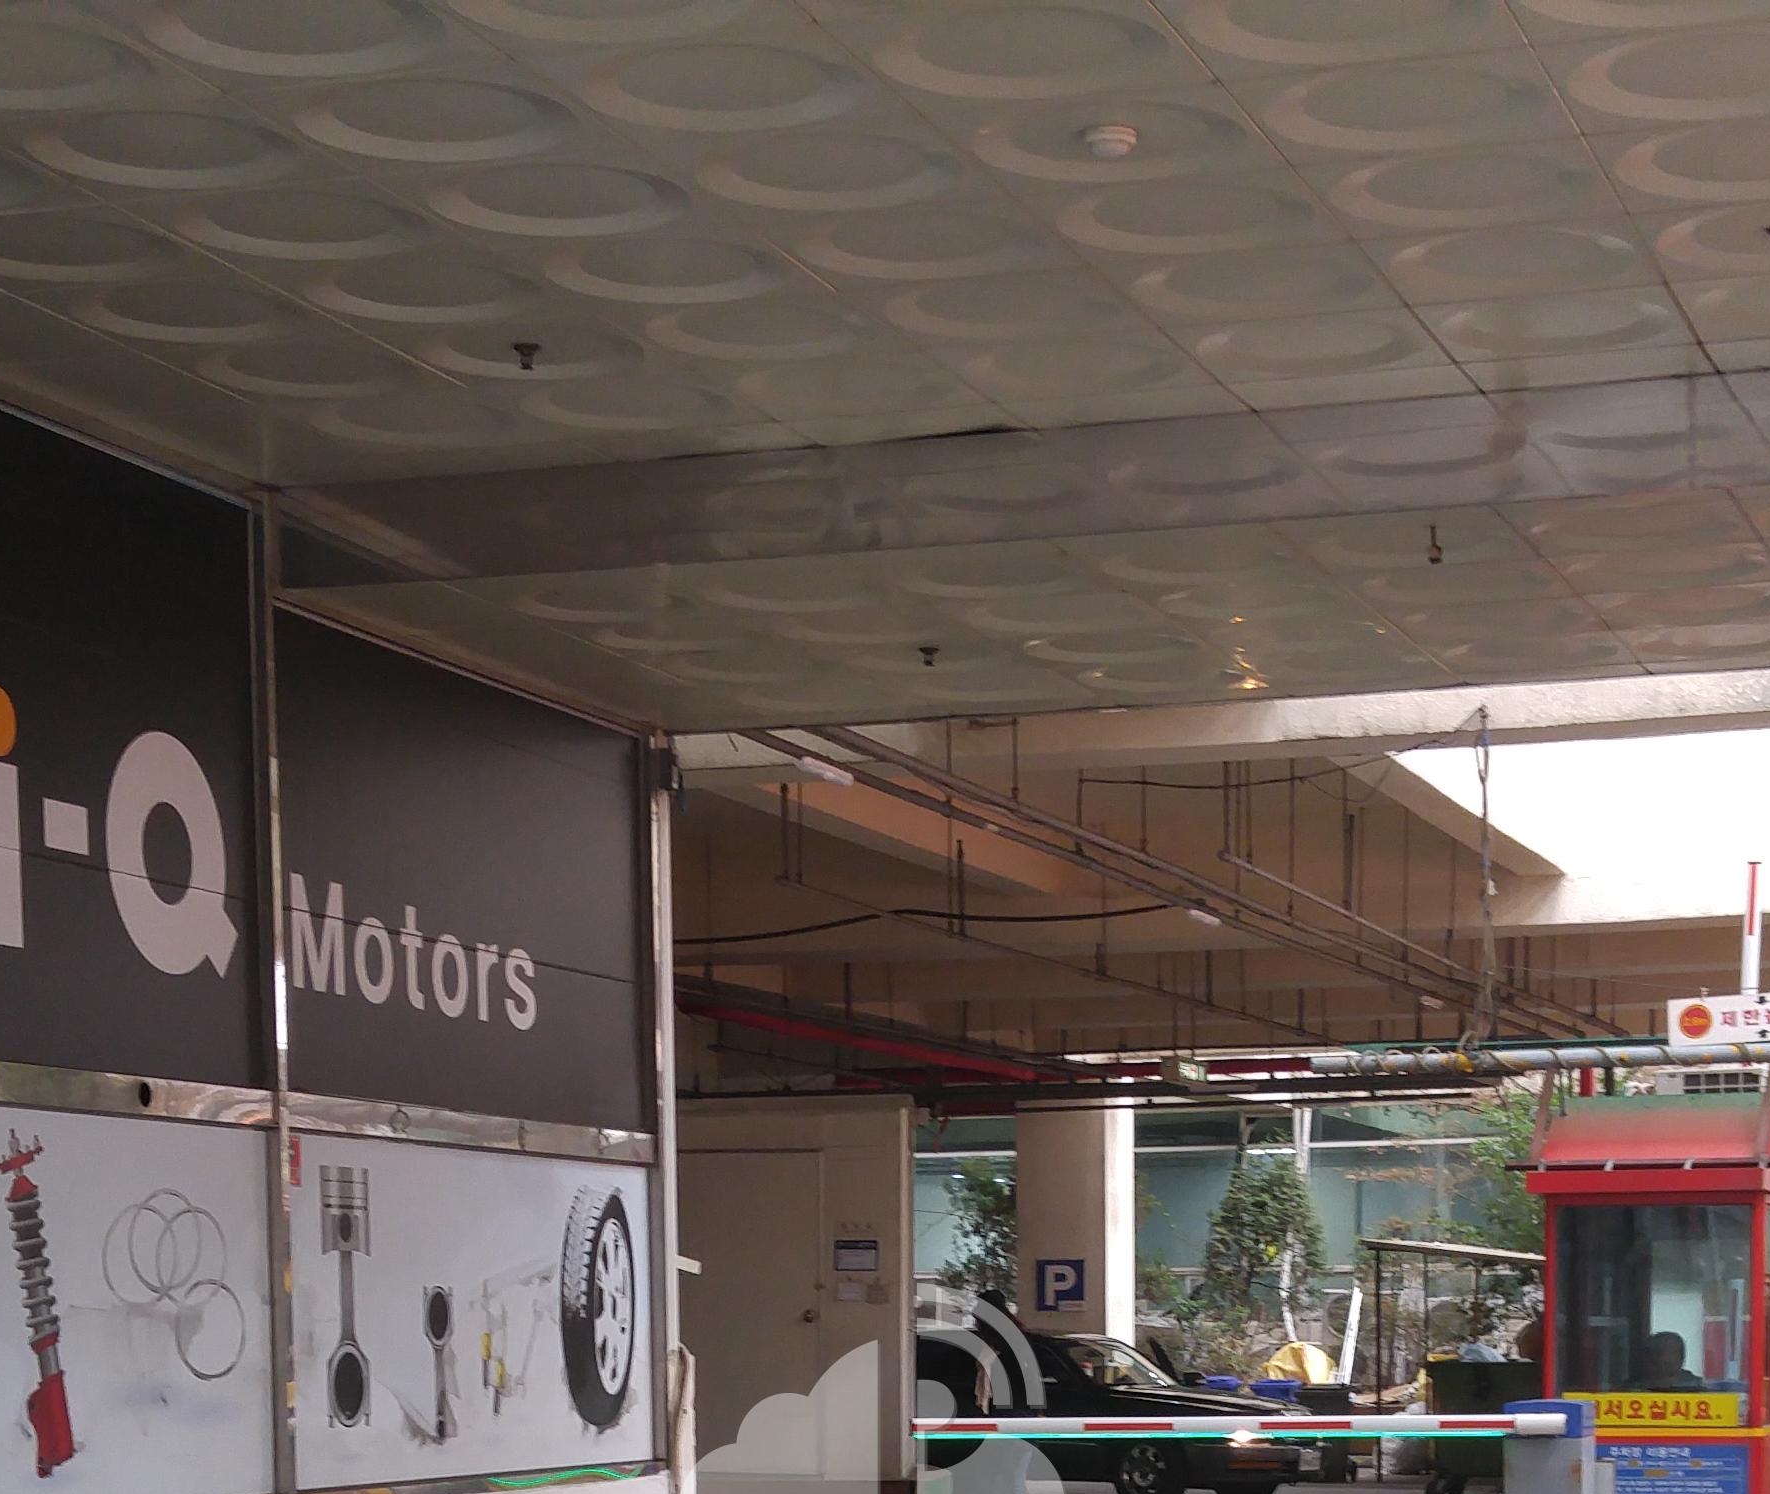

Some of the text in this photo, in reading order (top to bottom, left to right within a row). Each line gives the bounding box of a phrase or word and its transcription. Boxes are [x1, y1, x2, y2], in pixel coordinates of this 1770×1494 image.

[290, 872, 537, 1031] Motors
[1044, 1264, 1077, 1306] P
[1595, 1400, 1722, 1421] 서오십시요.
